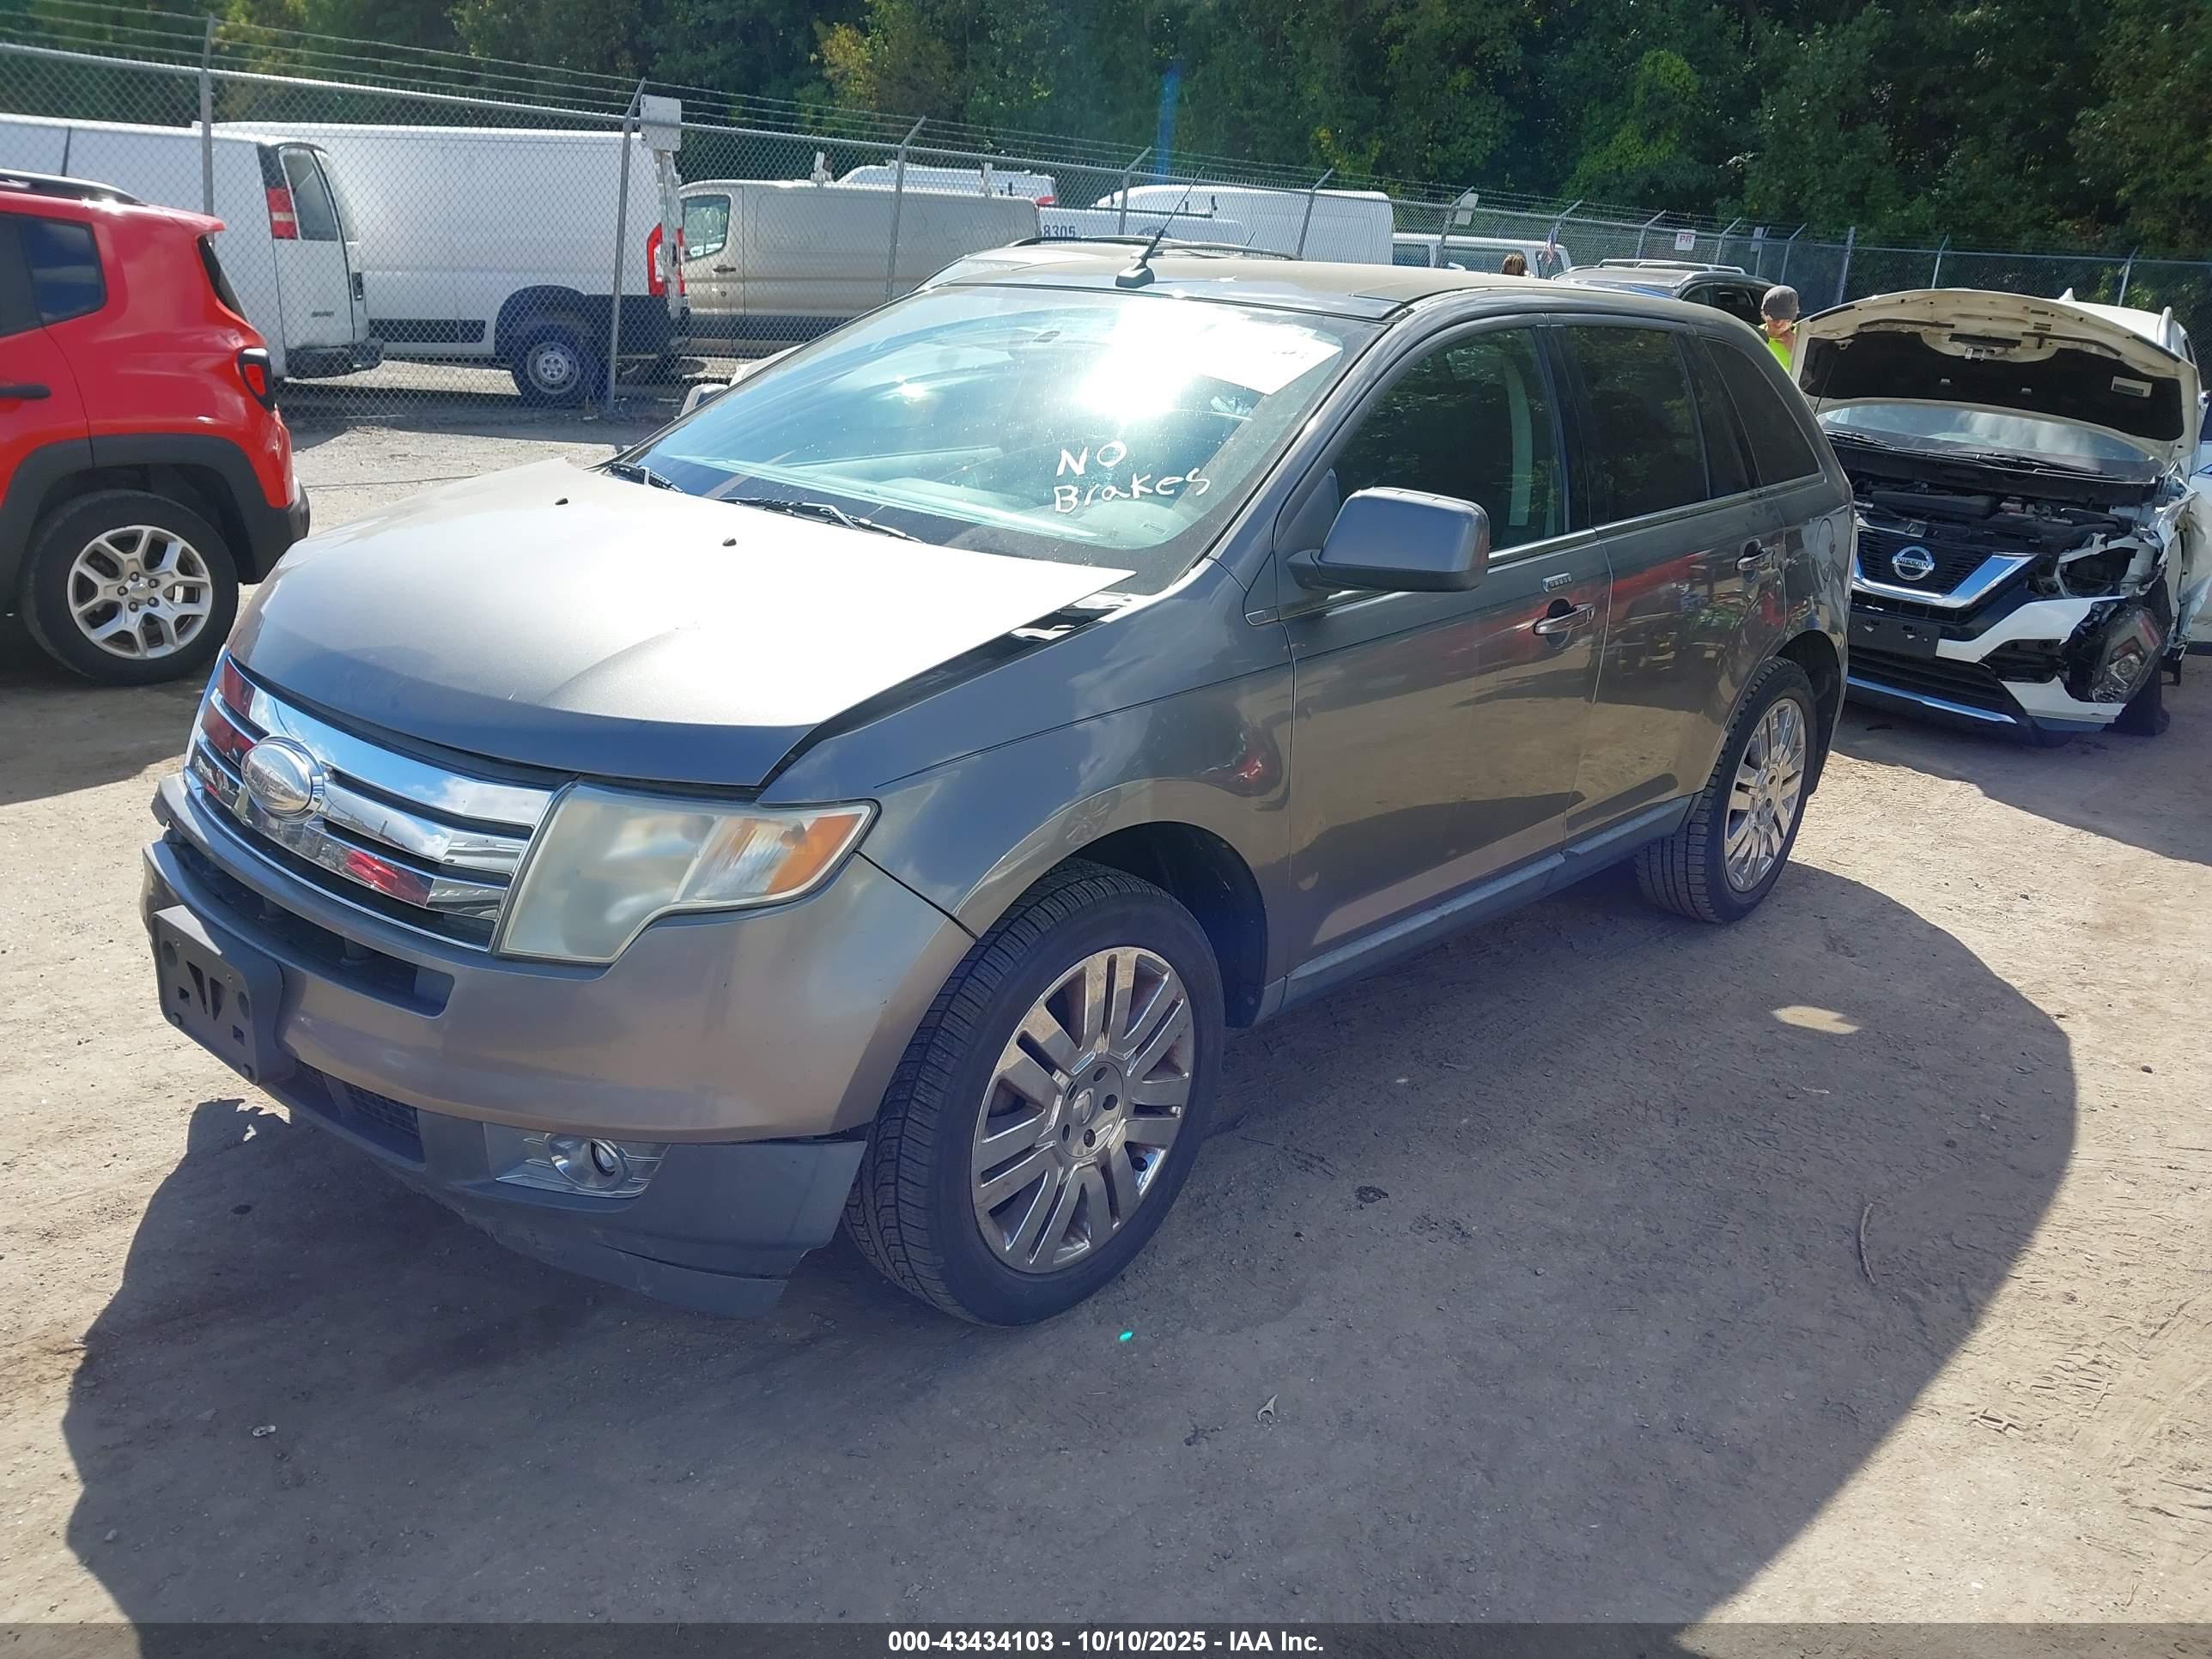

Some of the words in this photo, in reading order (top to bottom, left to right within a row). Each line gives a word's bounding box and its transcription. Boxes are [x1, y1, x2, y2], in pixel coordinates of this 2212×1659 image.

[1043, 225, 1075, 237] 8305
[1056, 441, 1127, 477] NO
[1054, 468, 1211, 514] Brakes
[1897, 557, 1931, 569] NISSAN
